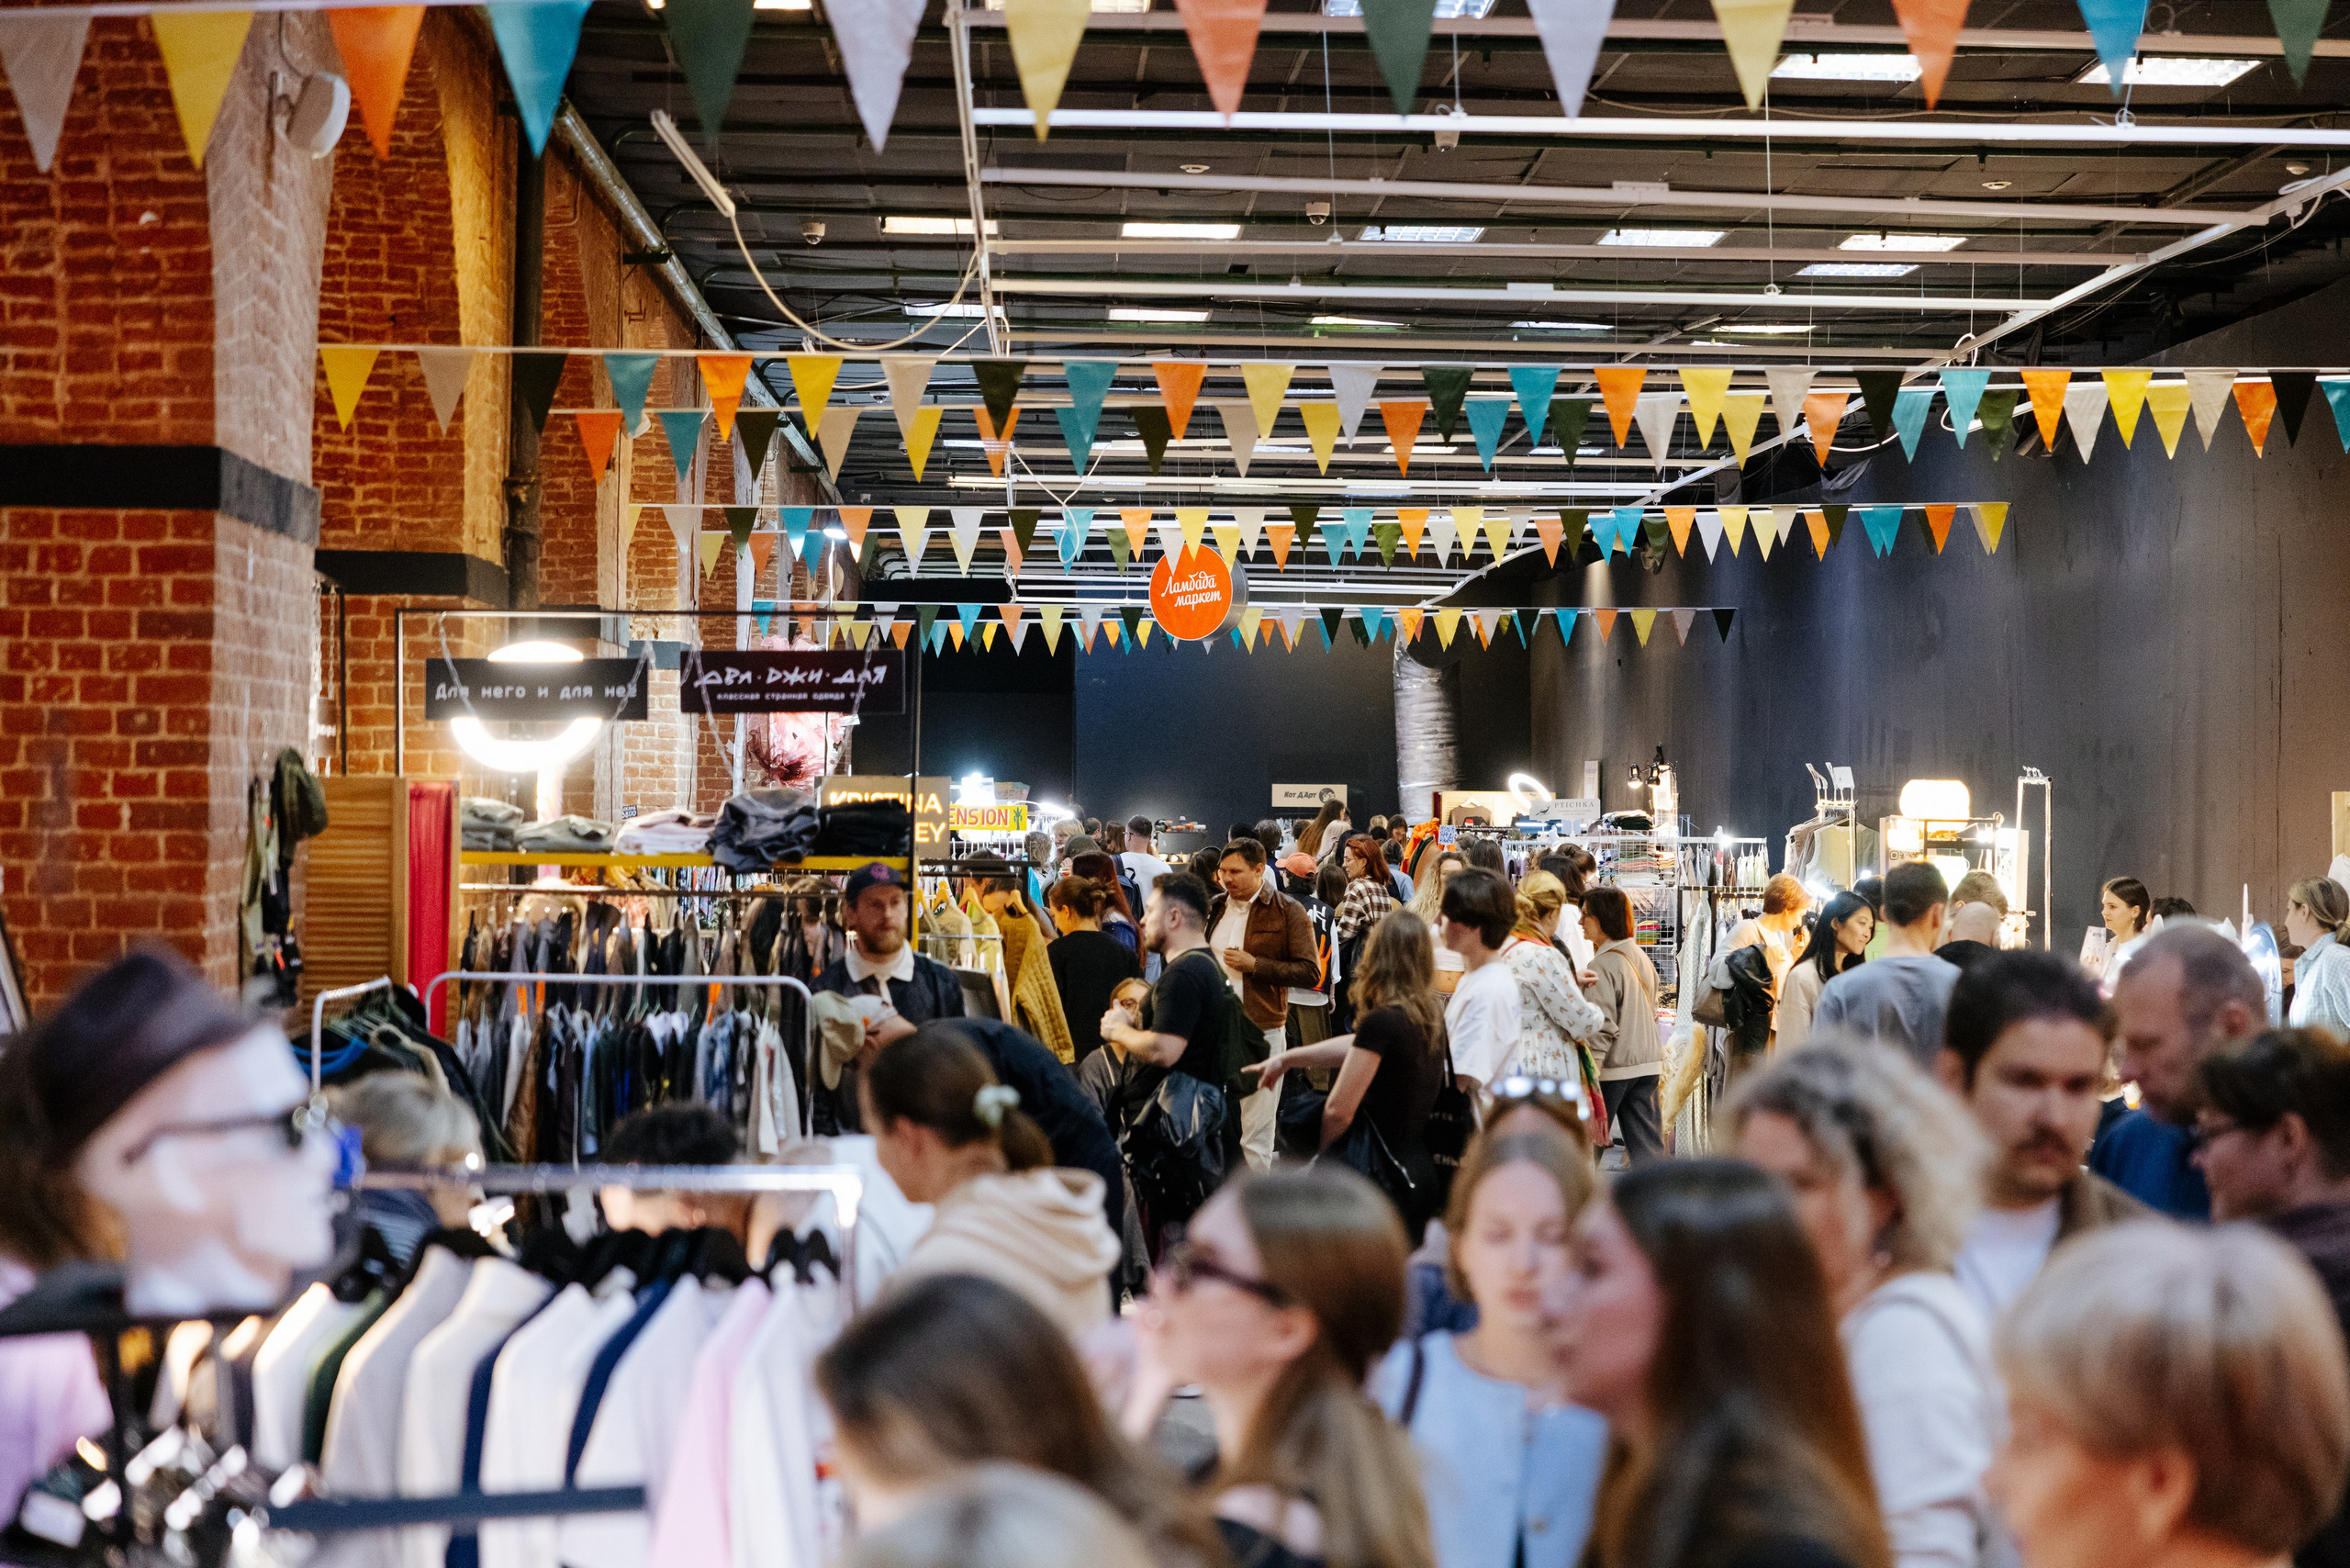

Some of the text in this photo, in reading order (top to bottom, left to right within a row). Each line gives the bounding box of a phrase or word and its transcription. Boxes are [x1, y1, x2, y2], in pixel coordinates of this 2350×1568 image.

[1160, 570, 1217, 598] Ламбада
[1174, 590, 1222, 610] маркет
[435, 682, 470, 700] Для
[481, 685, 527, 699] него
[537, 685, 549, 699] и
[559, 685, 593, 700] для
[849, 692, 867, 701] тт
